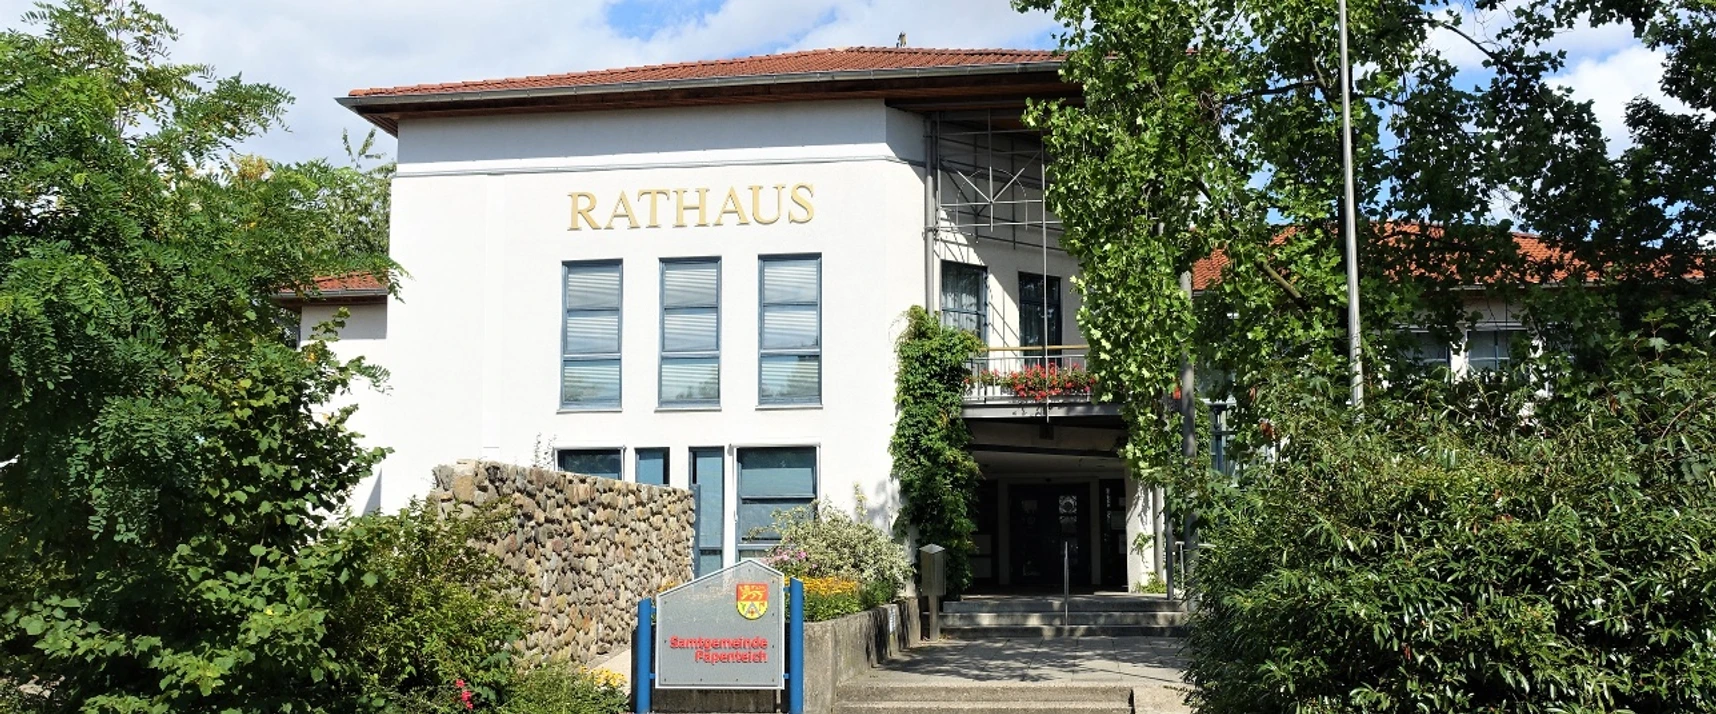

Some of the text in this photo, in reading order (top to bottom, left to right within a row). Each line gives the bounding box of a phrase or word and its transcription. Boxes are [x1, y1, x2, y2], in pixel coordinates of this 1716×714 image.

[567, 183, 815, 231] RATHAUS
[670, 636, 768, 651] Samtgemeinde
[695, 650, 768, 665] Papenteich
